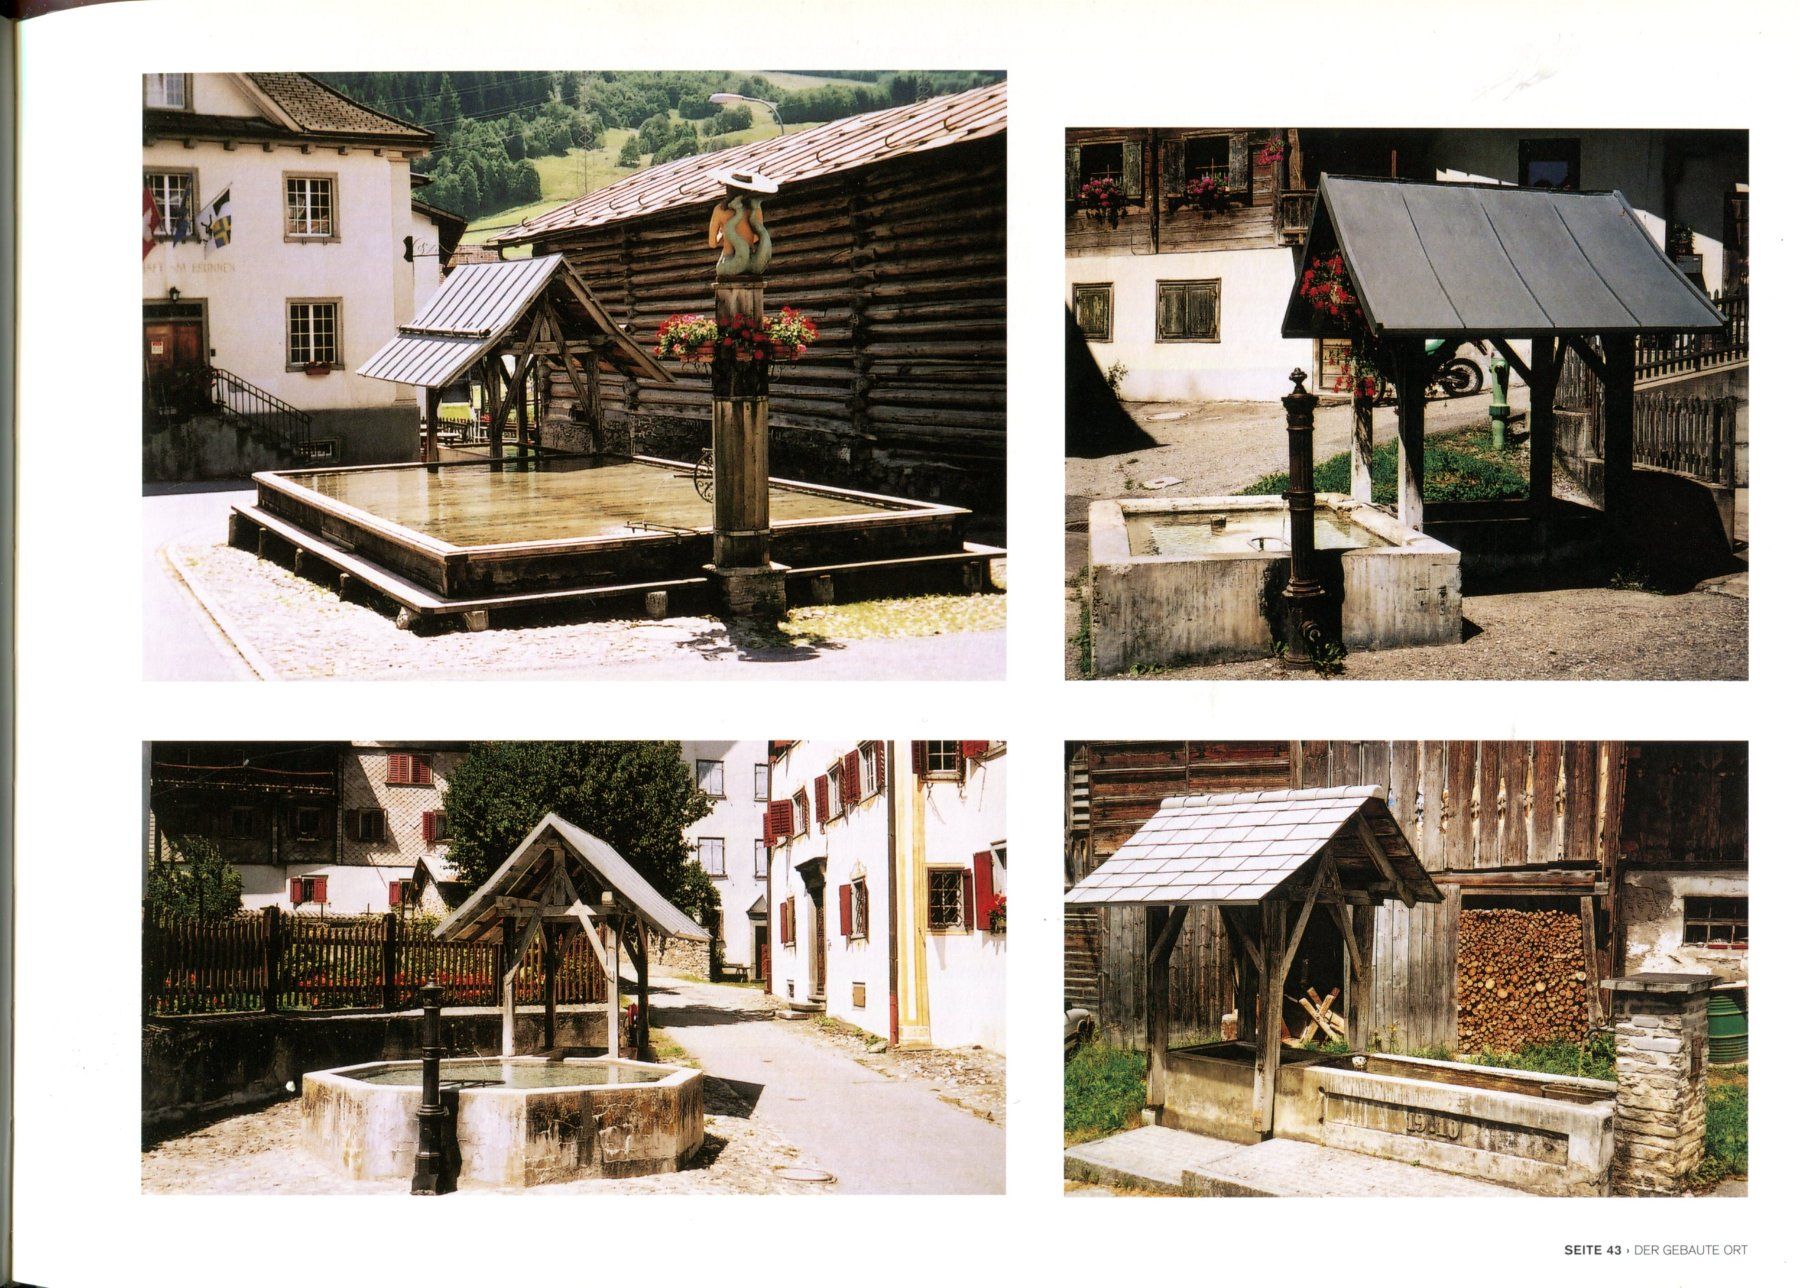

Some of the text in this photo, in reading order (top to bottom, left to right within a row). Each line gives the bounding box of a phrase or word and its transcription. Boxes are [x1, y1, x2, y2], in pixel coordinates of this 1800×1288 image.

[1564, 1244, 1748, 1256] SEITE 43 DER GEBAUTE ORT
